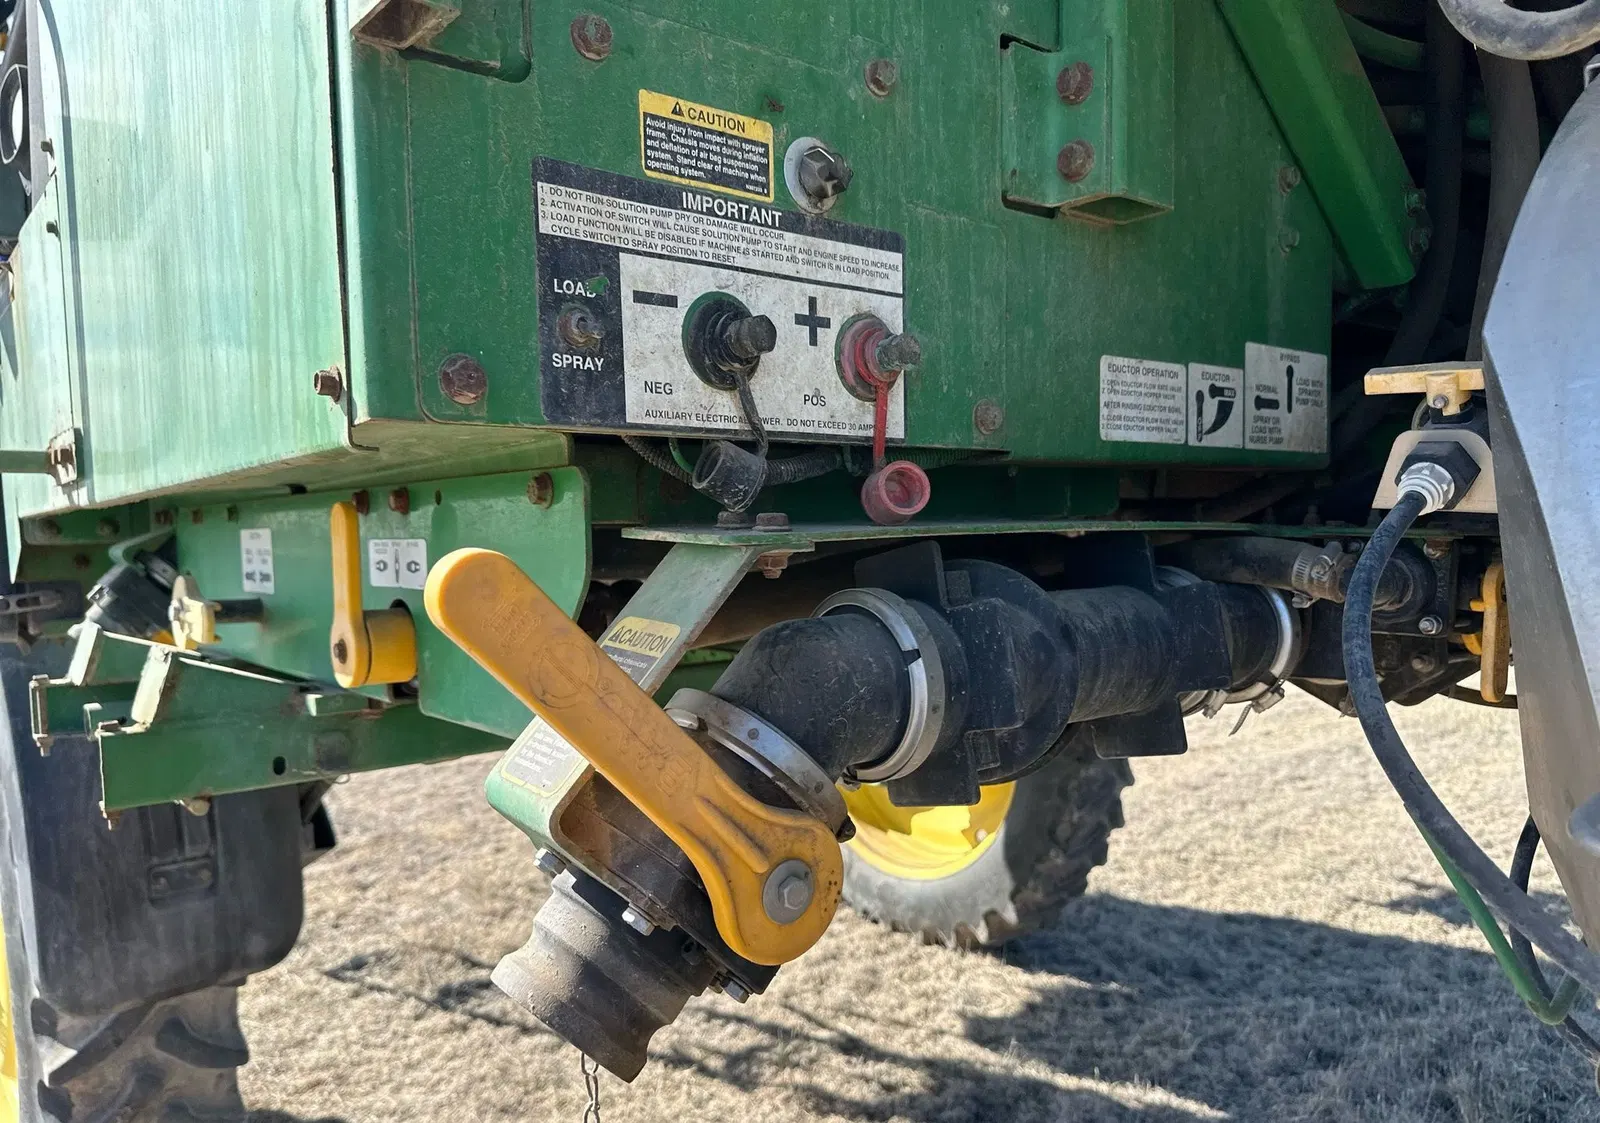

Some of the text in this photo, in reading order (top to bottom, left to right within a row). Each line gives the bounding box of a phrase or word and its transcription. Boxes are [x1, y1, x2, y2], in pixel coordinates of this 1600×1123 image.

[688, 108, 746, 133] CAUTION
[646, 117, 765, 155] Avoid injury from impact with sprayer
[671, 133, 698, 147] Chassis
[699, 140, 720, 152] moves
[722, 144, 742, 159] during
[743, 150, 768, 164] inflation
[646, 138, 759, 172] and deflation of air bag suspension
[646, 149, 766, 183] system. Stand clear of machine when
[646, 160, 706, 179] operating system.
[540, 185, 785, 241] 1. DO NOT RUN SOLUTION PUMP DRY OR DAMAGE WILL OCCUR.
[682, 191, 782, 227] IMPORTANT
[540, 199, 547, 207] 2.
[550, 199, 602, 217] ACTIVATION
[605, 210, 616, 220] OF
[618, 213, 650, 227] SWITCH
[652, 220, 671, 230] WILL
[673, 222, 700, 235] CAUSE
[702, 229, 740, 242] SOLUTION
[742, 236, 761, 246] PUMP
[764, 240, 772, 249] TO
[774, 242, 796, 254] START
[798, 246, 812, 257] AND
[814, 250, 838, 261] ENGINE
[839, 254, 860, 265] SPEED
[861, 257, 869, 266] TO
[540, 211, 548, 219] 3.
[550, 212, 575, 224] LOAD
[577, 217, 621, 232] FUNCTION
[623, 226, 642, 237] WILL
[644, 230, 655, 239] BE
[658, 232, 697, 246] DISABLED
[708, 241, 742, 254] MACHINE
[742, 248, 750, 256] IS
[752, 249, 784, 262] STARTED
[786, 254, 799, 264] AND
[801, 258, 826, 270] SWITCH
[827, 262, 834, 270] IS
[842, 265, 860, 275] LOAD
[861, 268, 890, 280] POSITION.
[551, 224, 580, 237] CYCLE
[582, 230, 616, 244] SWITCH
[618, 235, 629, 245] TO
[631, 238, 658, 250] SPRAY
[661, 244, 698, 257] POSITION
[699, 250, 710, 259] TO
[552, 353, 604, 371] SPRAY
[1108, 363, 1179, 379] EDUCTOR OPERATION
[644, 380, 673, 395] NEG
[1201, 371, 1230, 382] EDUCTOR
[803, 394, 826, 406] POS
[645, 409, 692, 420] AUXILIARY
[695, 413, 749, 424] ELECTRICAL
[761, 416, 783, 426] WER.
[786, 418, 798, 426] DO
[818, 421, 846, 430] EXCEED
[848, 422, 856, 430] 30
[619, 628, 673, 654] CAUTION
